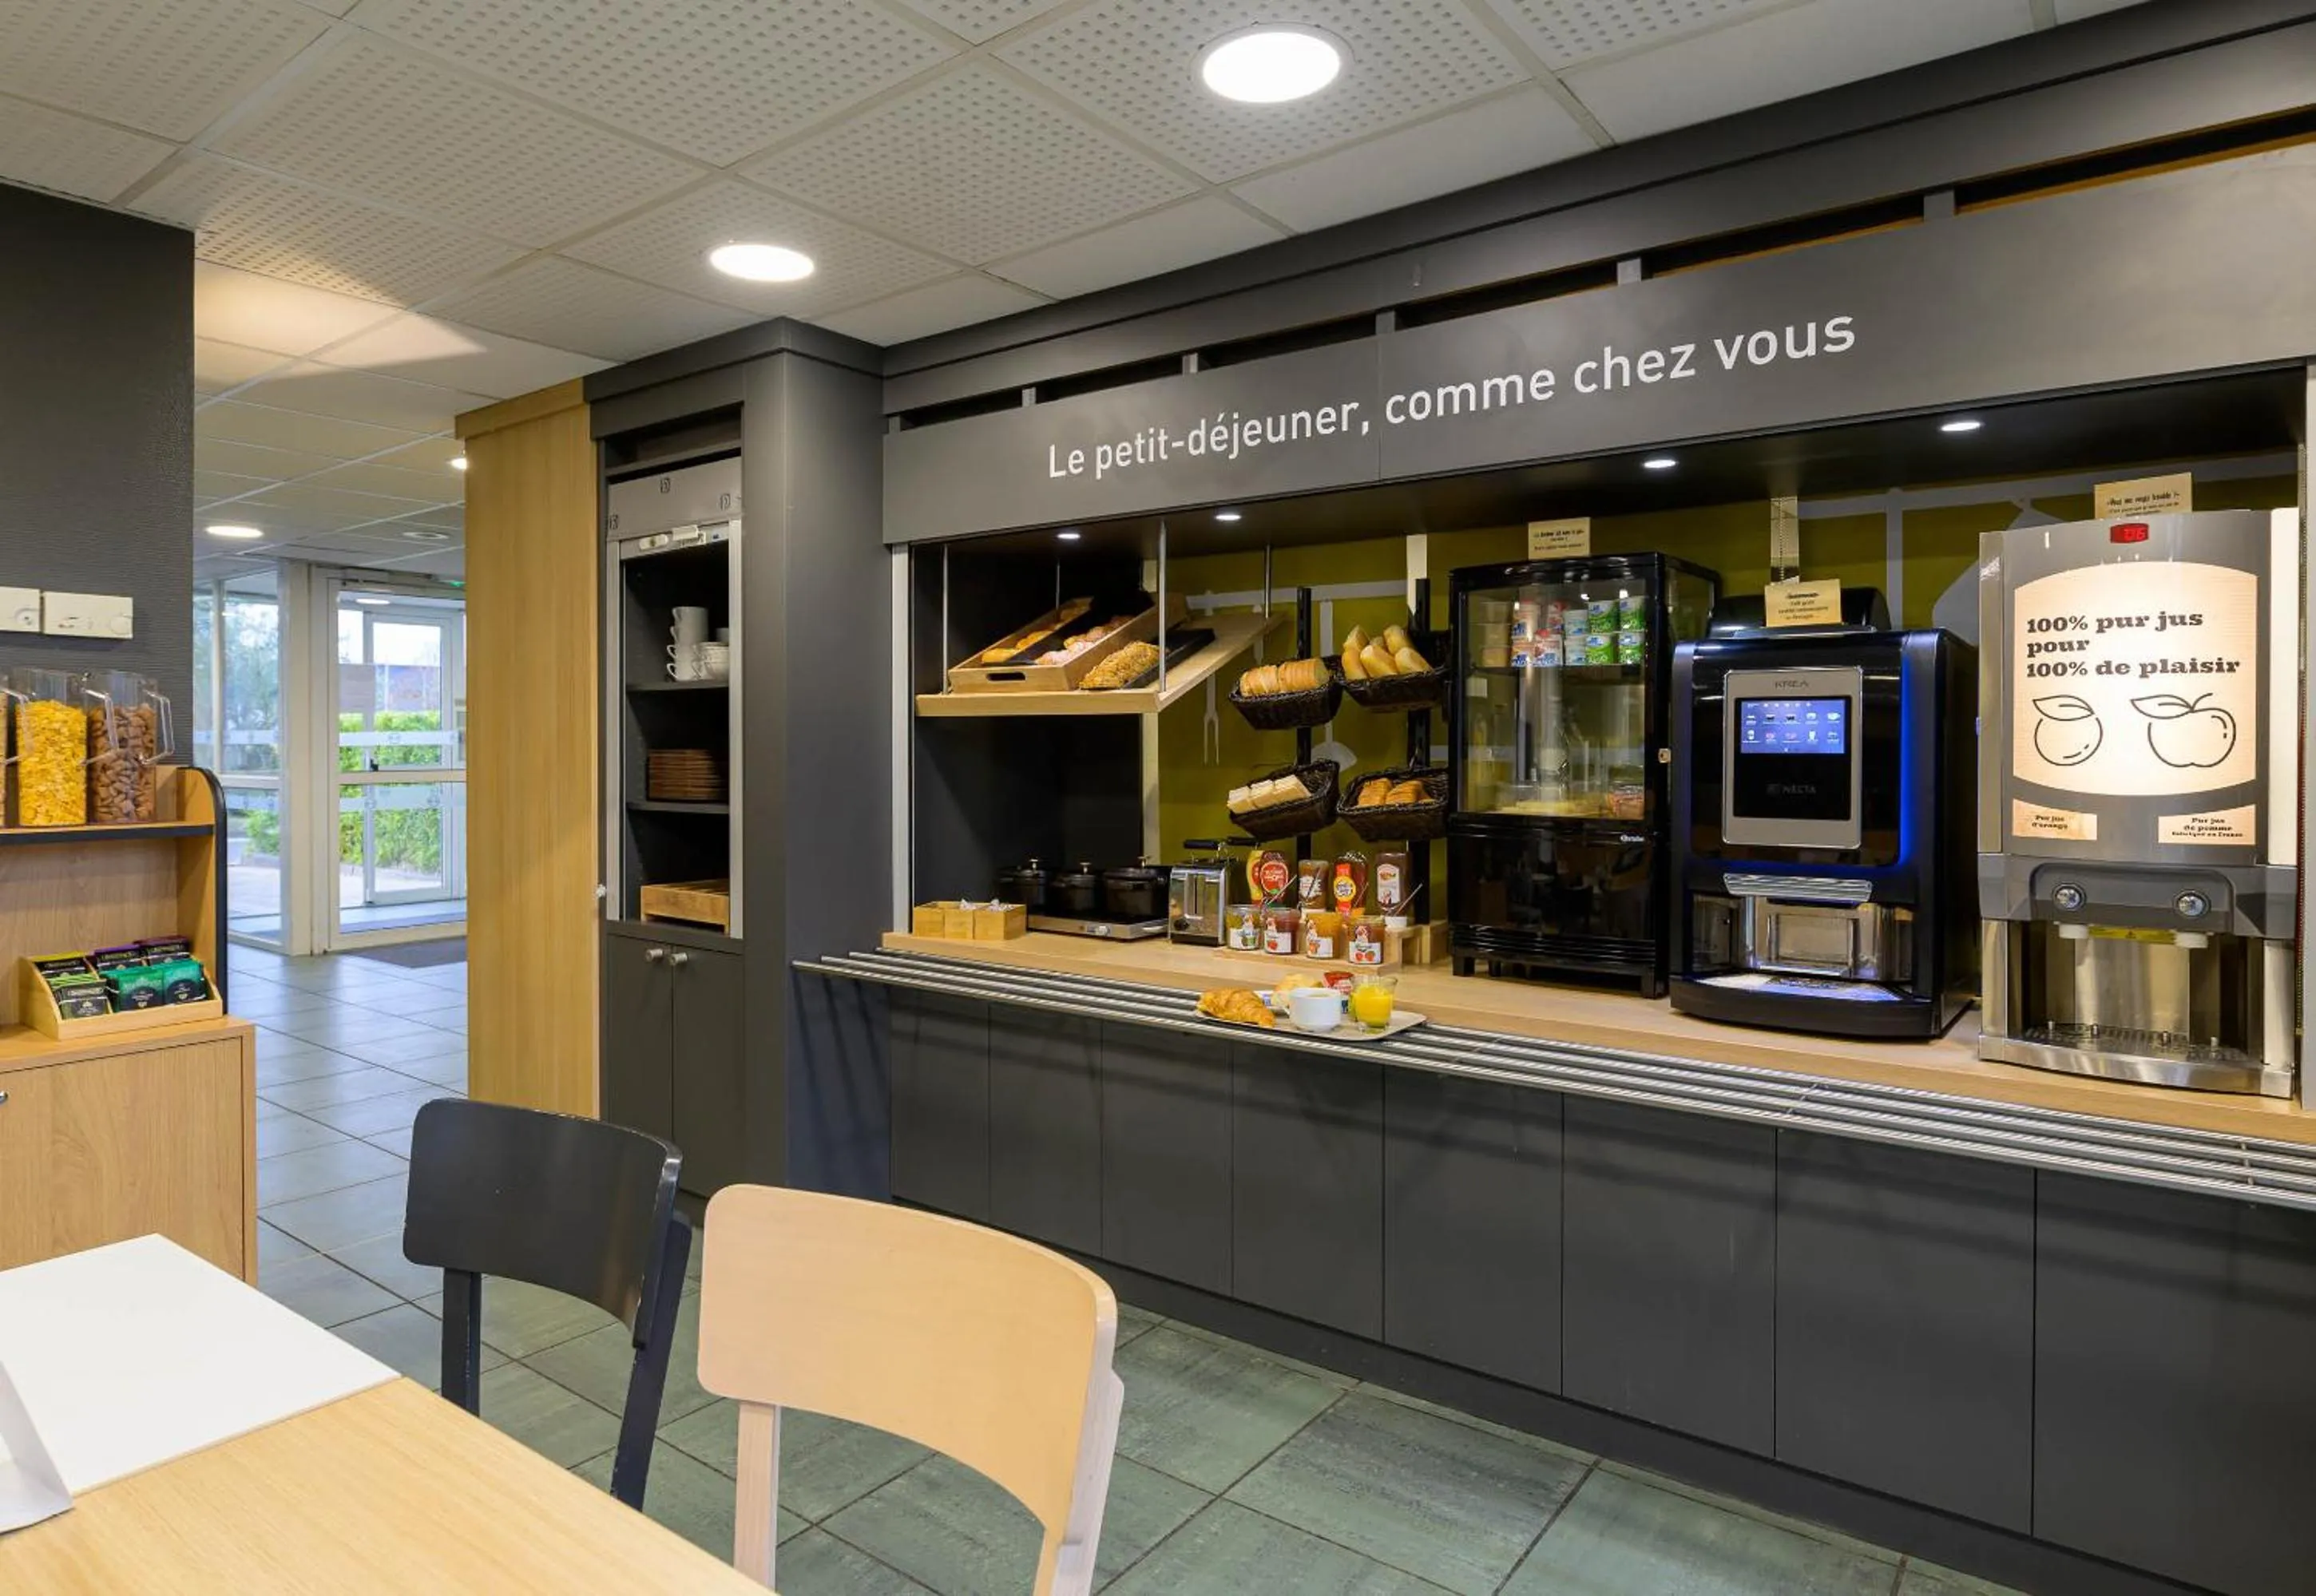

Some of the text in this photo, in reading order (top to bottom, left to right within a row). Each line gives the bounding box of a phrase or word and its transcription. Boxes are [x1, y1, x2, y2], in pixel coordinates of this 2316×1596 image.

[1049, 315, 1855, 481] Le petit-déjeuner, comme chez vous
[2026, 610, 2203, 634] 100% pur jus
[2026, 640, 2090, 659] pour
[2026, 656, 2241, 679] 100% de plaisir
